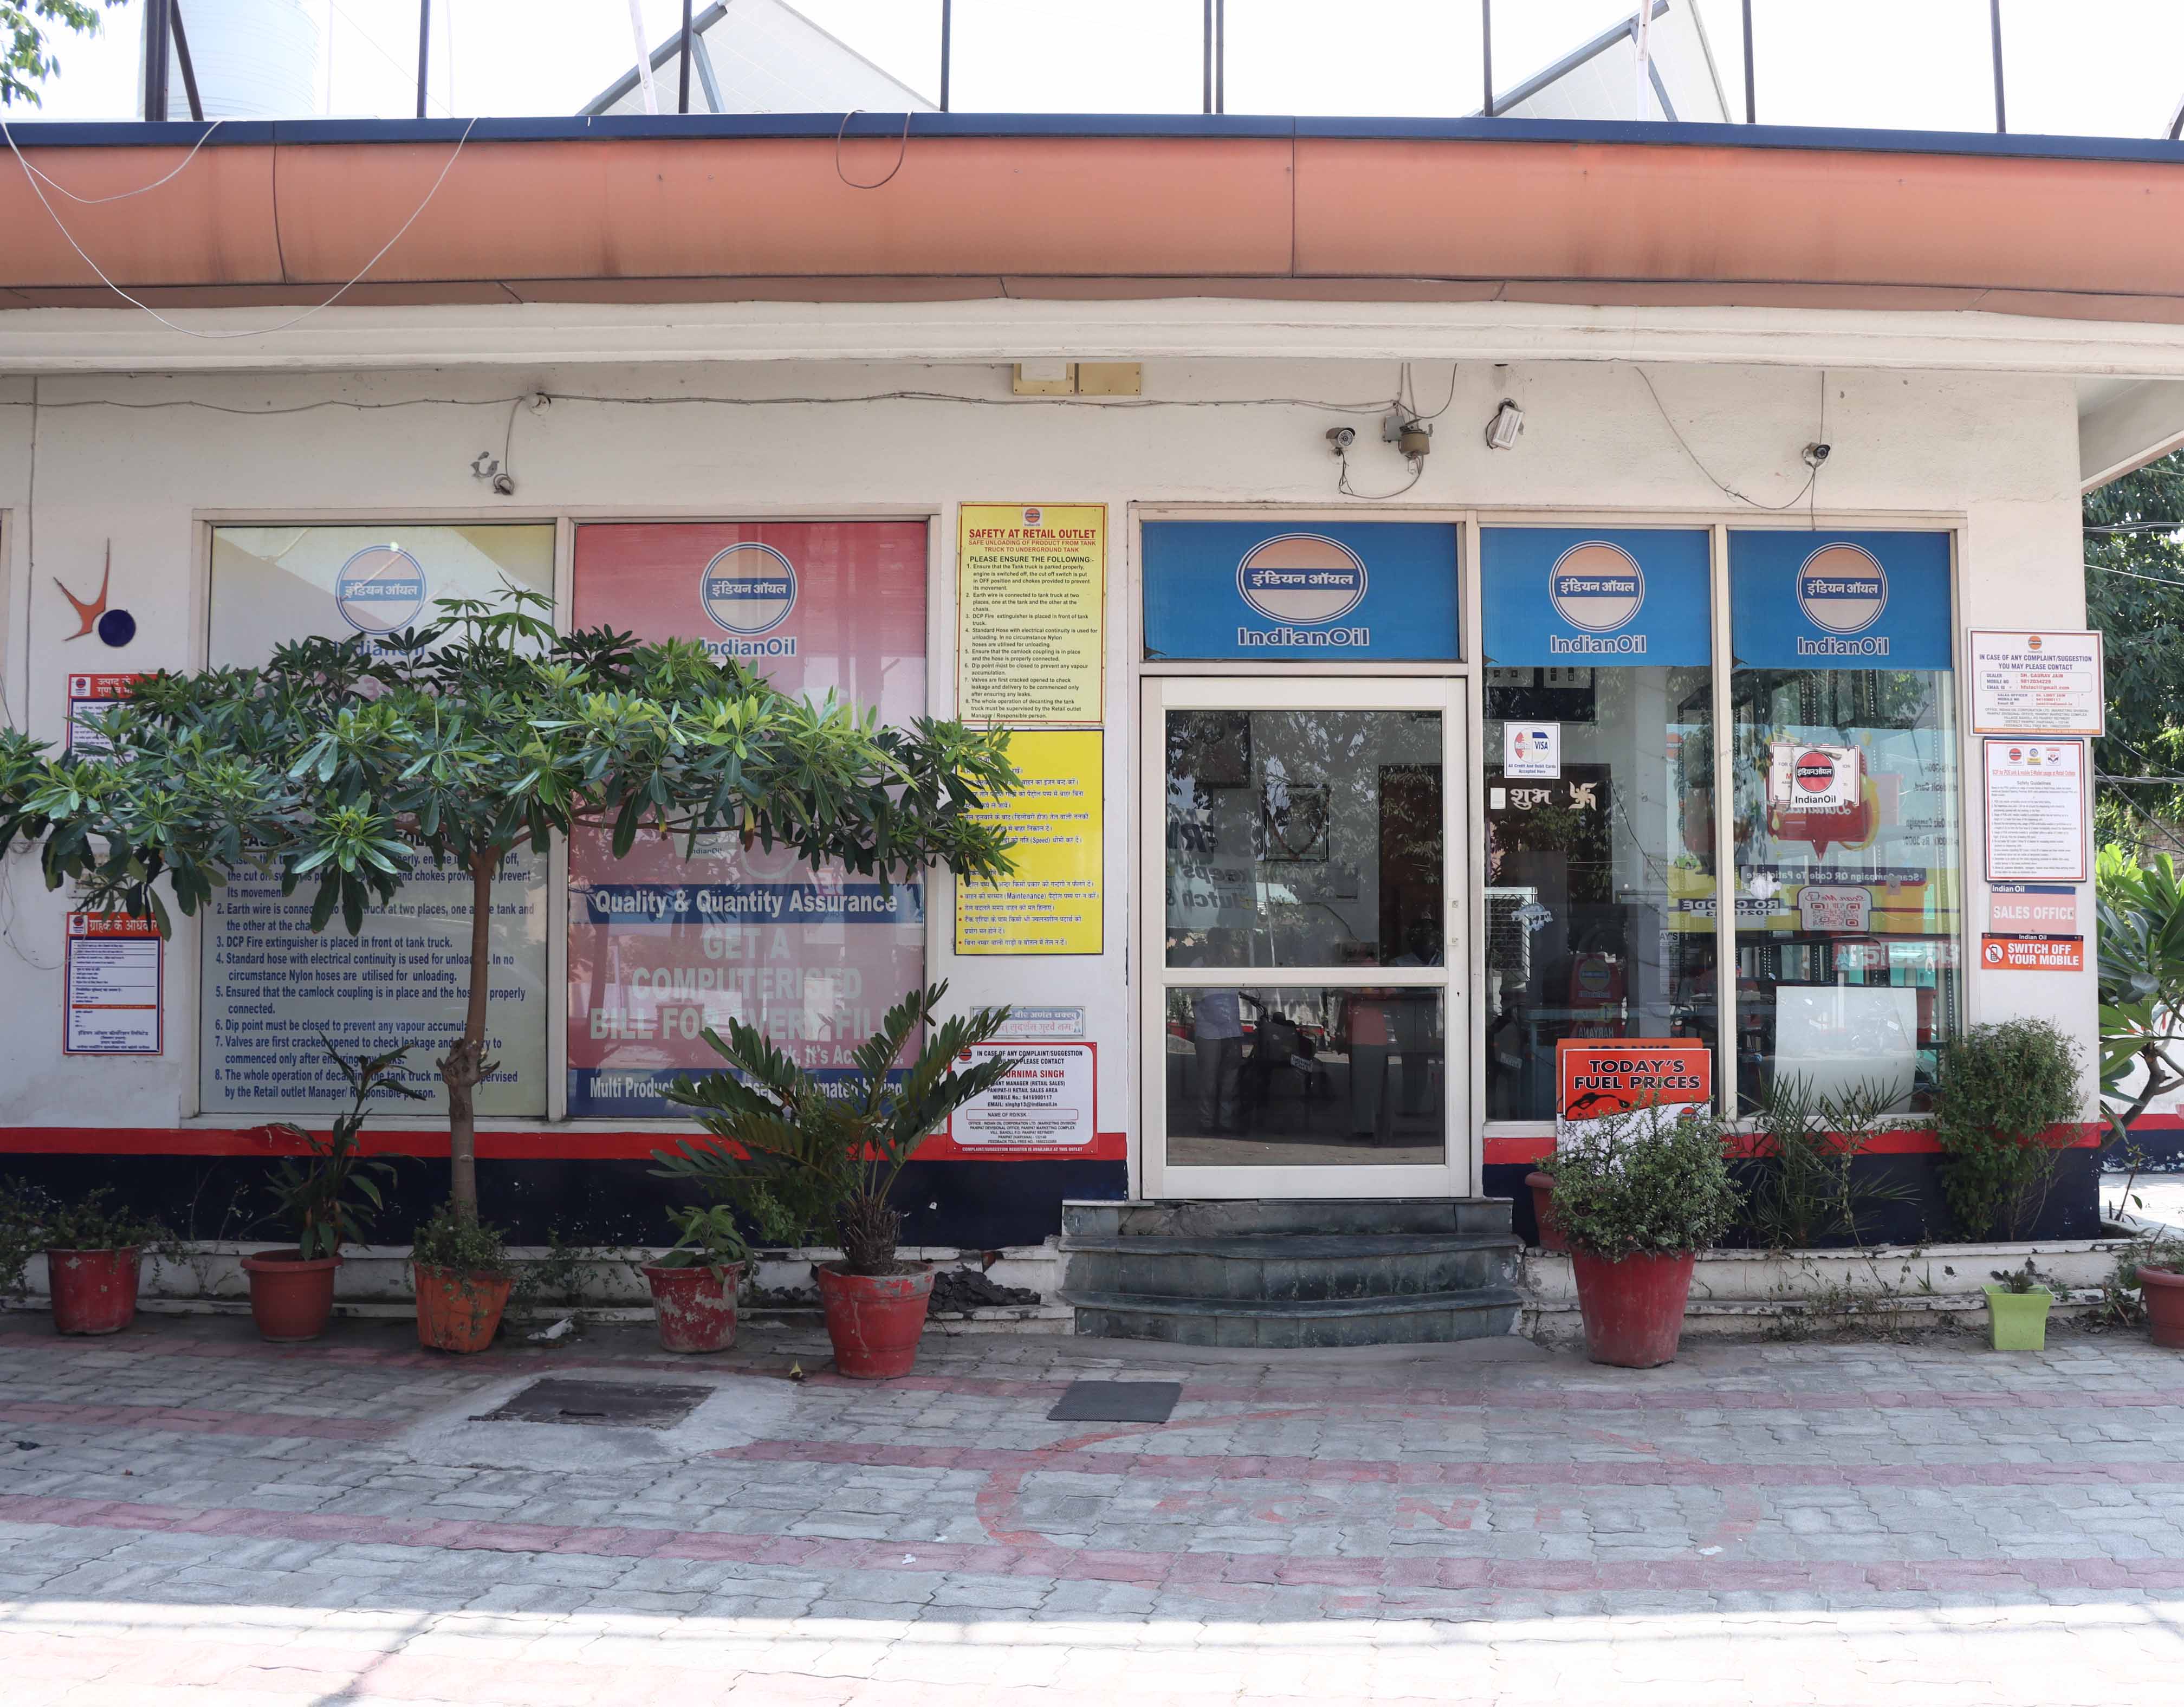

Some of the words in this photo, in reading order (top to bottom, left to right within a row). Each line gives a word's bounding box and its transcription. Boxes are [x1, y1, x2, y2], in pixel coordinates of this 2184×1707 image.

[969, 529, 1004, 538] SAFETY
[1008, 529, 1020, 538] AT
[1023, 529, 1055, 538] RETAIL
[1059, 529, 1096, 538] OUTLET
[1252, 570, 1306, 586] इंडियन
[1308, 570, 1354, 585] ऑयल
[345, 583, 383, 598] इंडियन
[385, 583, 418, 595] ऑयल
[711, 580, 751, 597] इंडियन
[753, 580, 786, 595] ऑयल
[1560, 578, 1600, 594] इंडियन
[1602, 578, 1635, 592] ऑयल
[1807, 580, 1845, 596] इंडियन
[1846, 580, 1878, 594] ऑयल
[1237, 628, 1370, 646] IndianOil
[1550, 635, 1647, 653] IndianOil
[1797, 636, 1889, 655] IndianOil
[1534, 741, 1548, 749] VISA
[1510, 788, 1552, 810] शुभ
[1795, 795, 1836, 804] IndianOil
[595, 890, 667, 918] Quality
[674, 893, 689, 912] &
[696, 890, 783, 918] Quantity
[789, 889, 897, 913] Assurance
[1004, 892, 1046, 900] (Maintenance)
[1993, 906, 2030, 920] SALES
[2034, 907, 2074, 920] OFFICE
[703, 928, 761, 960] GET
[771, 928, 790, 959] A
[2008, 943, 2049, 954] SWITCH
[2052, 944, 2072, 954] OFF
[2008, 954, 2037, 965] YOUR
[2040, 954, 2079, 966] MOBILE
[229, 969, 286, 981] circumstance
[289, 969, 313, 984] Nylon
[316, 969, 340, 981] hoses
[342, 972, 357, 981] are
[362, 969, 393, 981] utilised
[396, 969, 407, 981] for
[413, 969, 457, 984] unloading.
[216, 986, 223, 997] 5.
[226, 986, 260, 997] Ensured
[263, 986, 280, 997] that
[282, 986, 296, 997] the
[299, 986, 334, 997] camlock
[337, 986, 373, 1000] coupling
[376, 986, 383, 997] is
[386, 986, 393, 997] in
[396, 986, 419, 1000] place
[422, 986, 437, 998] and
[440, 986, 454, 998] the
[490, 986, 525, 1001] properly
[229, 1003, 275, 1014] connected.
[590, 1008, 653, 1040] BILL
[1589, 1060, 1685, 1074] TODAY'S
[590, 1077, 621, 1098] Multi
[1574, 1076, 1622, 1090] FUEL
[1630, 1076, 1701, 1090] PRICES
